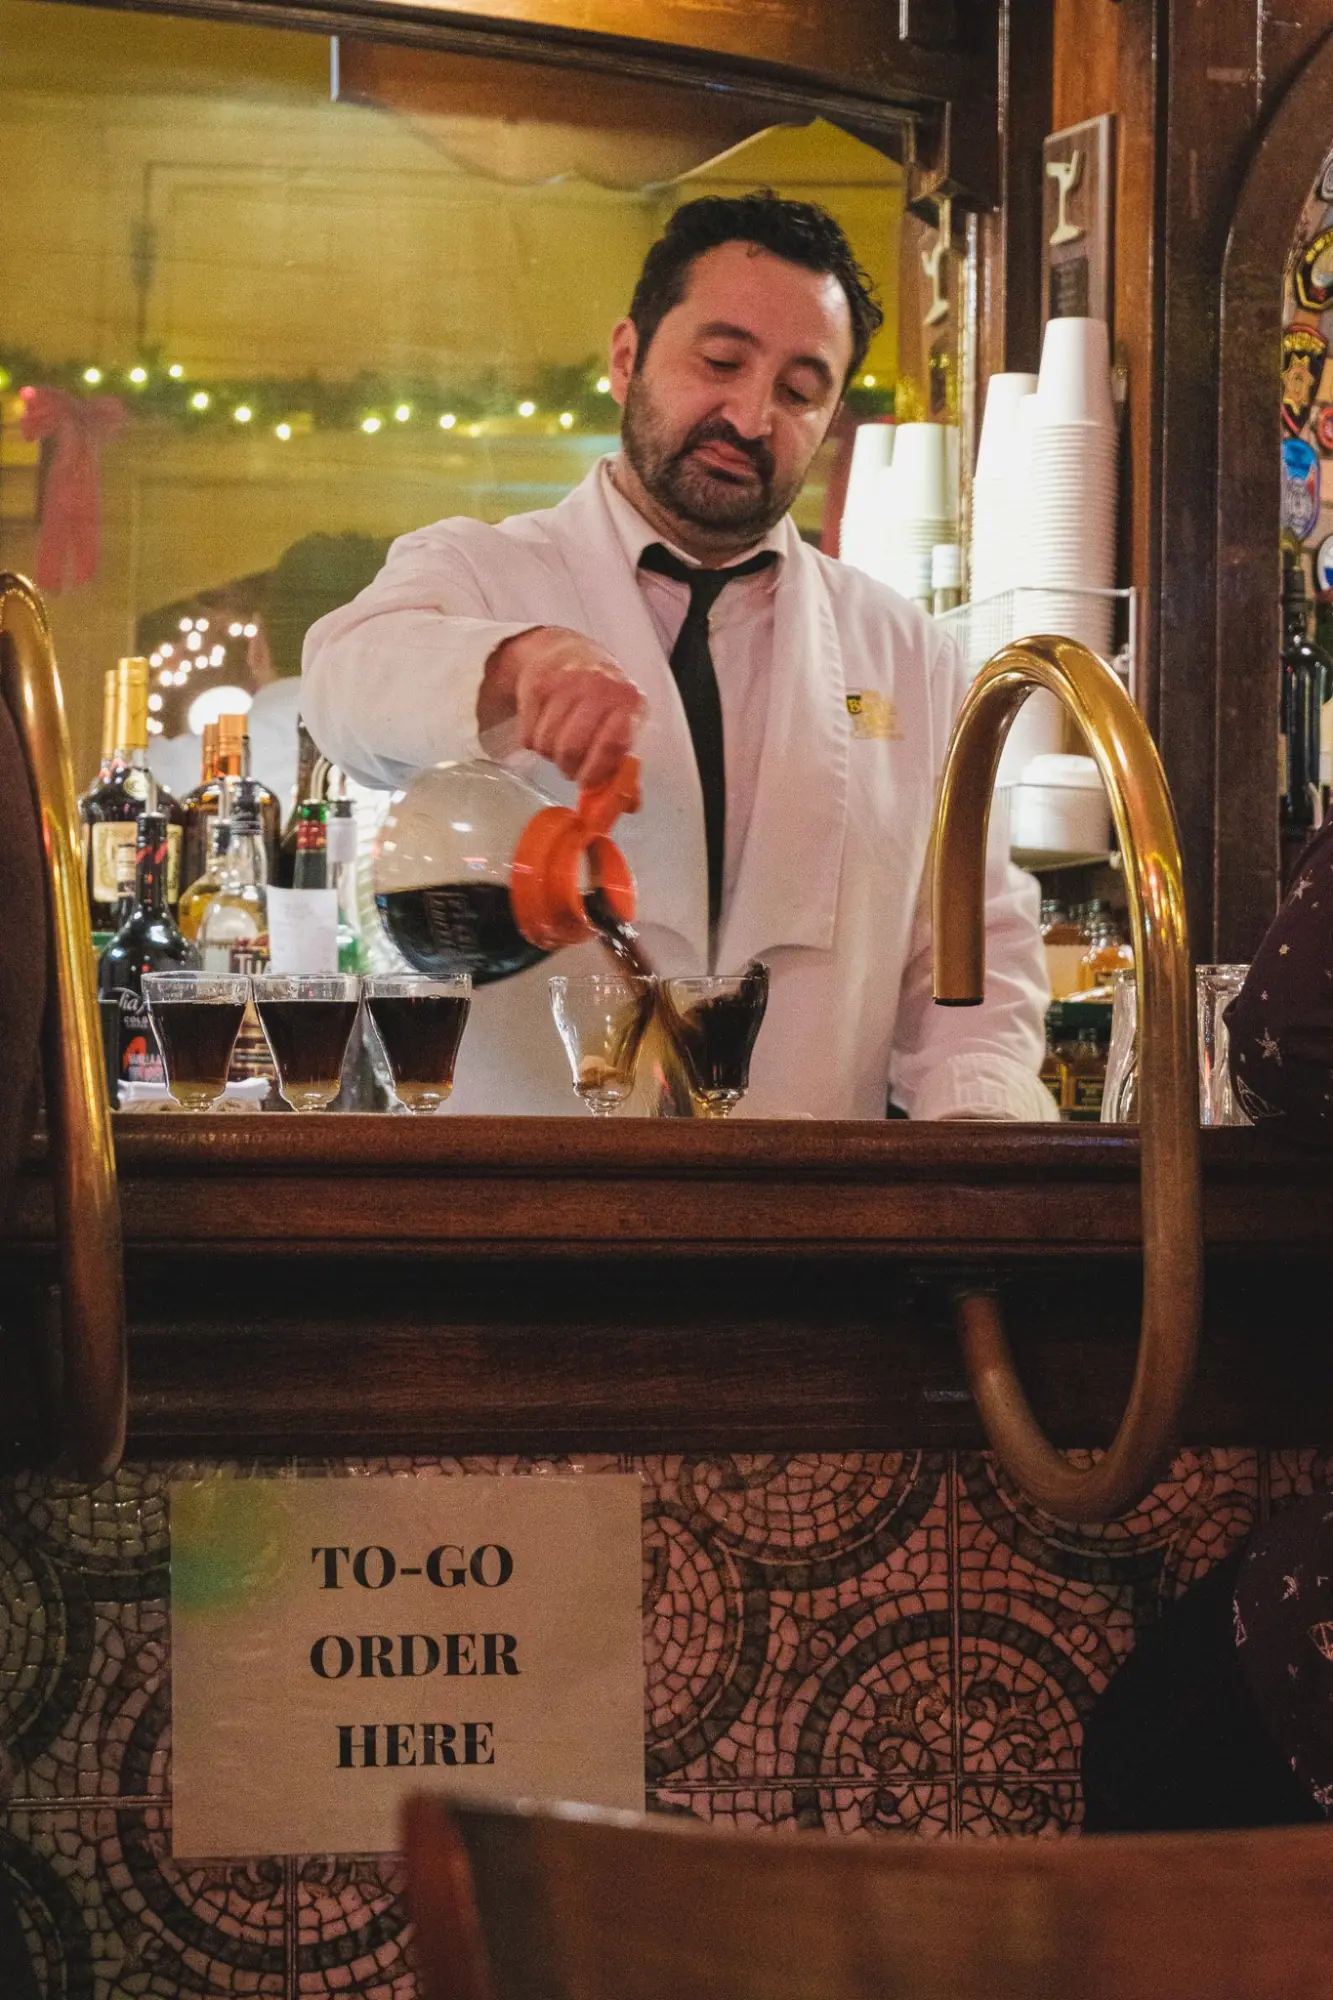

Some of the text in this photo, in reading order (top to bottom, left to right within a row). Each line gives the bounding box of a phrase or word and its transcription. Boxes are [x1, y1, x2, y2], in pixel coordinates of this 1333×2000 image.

[311, 1544, 513, 1589] TO-GO
[310, 1633, 521, 1679] ORDER
[336, 1722, 495, 1768] HERE
